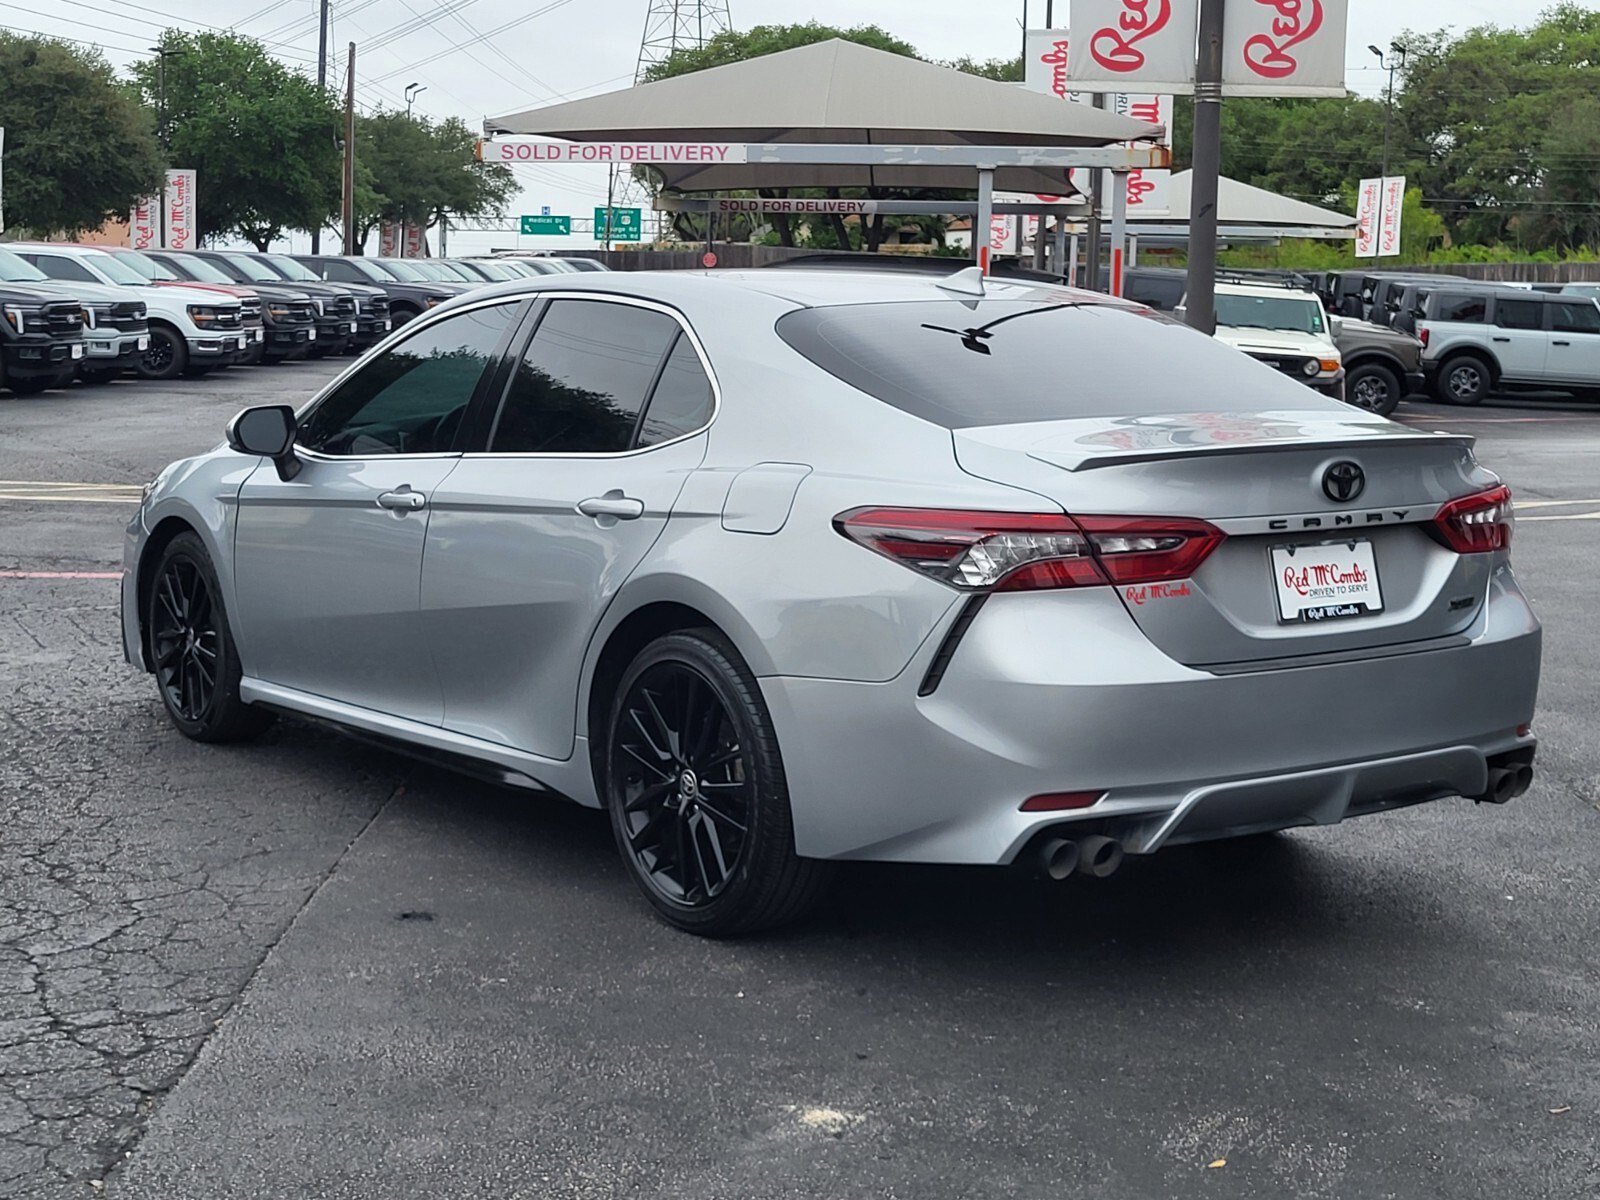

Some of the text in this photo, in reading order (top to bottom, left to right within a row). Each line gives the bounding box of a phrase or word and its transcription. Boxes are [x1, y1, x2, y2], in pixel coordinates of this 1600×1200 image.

[501, 144, 729, 161] SOLD FOR DELIVERY
[171, 175, 189, 249] Red McCombs
[719, 200, 866, 212] SOLD FOR DELIVERY
[136, 226, 154, 249] Red
[1269, 510, 1409, 530] CAMRY
[1283, 562, 1367, 595] Red McCombs
[1126, 582, 1191, 605] Red McCombs
[1309, 584, 1369, 598] DRIVEN TO SERVE
[1307, 607, 1325, 620] Red
